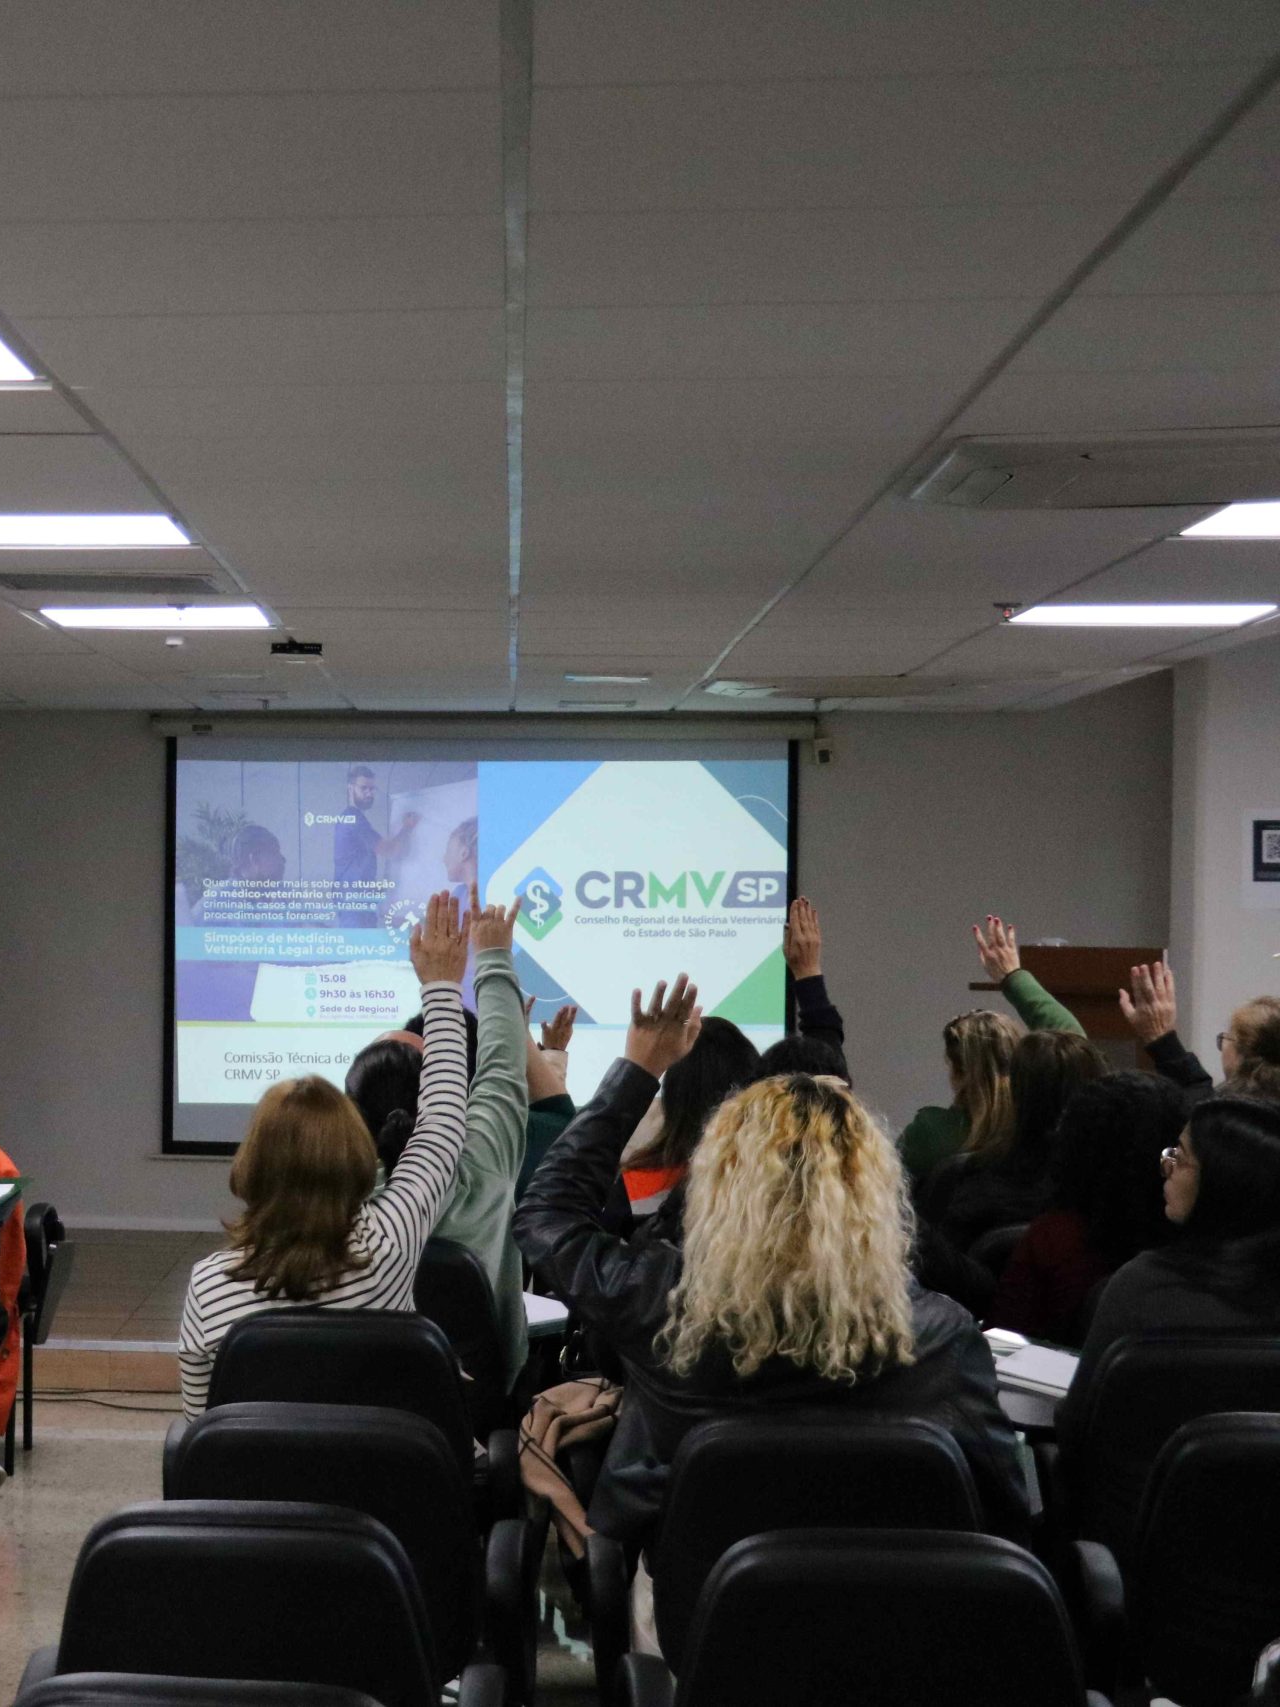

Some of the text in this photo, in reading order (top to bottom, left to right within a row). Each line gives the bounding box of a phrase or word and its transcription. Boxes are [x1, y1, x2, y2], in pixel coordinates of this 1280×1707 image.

[203, 878, 230, 888] Quer
[232, 879, 280, 888] entender
[284, 879, 309, 888] mais
[311, 879, 340, 888] sobre
[352, 879, 396, 890] atuação
[575, 870, 779, 909] CRMV SP
[203, 889, 386, 900] do médico-veterinário em perícias
[203, 900, 254, 910] criminais,
[288, 900, 300, 909] de
[304, 901, 368, 910] maus-tratos
[370, 902, 377, 910] e
[203, 911, 336, 921] procedimentos forenses?
[574, 915, 787, 927] Conselho Regional de Medicina Veterinária
[204, 931, 345, 944] Simpósio de Medicina
[623, 928, 737, 937] do Estado de São Paulo
[278, 944, 313, 957] Legal
[316, 945, 333, 954] do
[336, 945, 396, 955] CRMV-SP
[319, 974, 346, 983] 15.08
[319, 990, 395, 999] 9h30 às 16h30
[320, 1005, 399, 1014] Sede do Regional
[224, 1052, 350, 1064] Comissão Técnica de
[224, 1068, 280, 1080] CRMV SP
